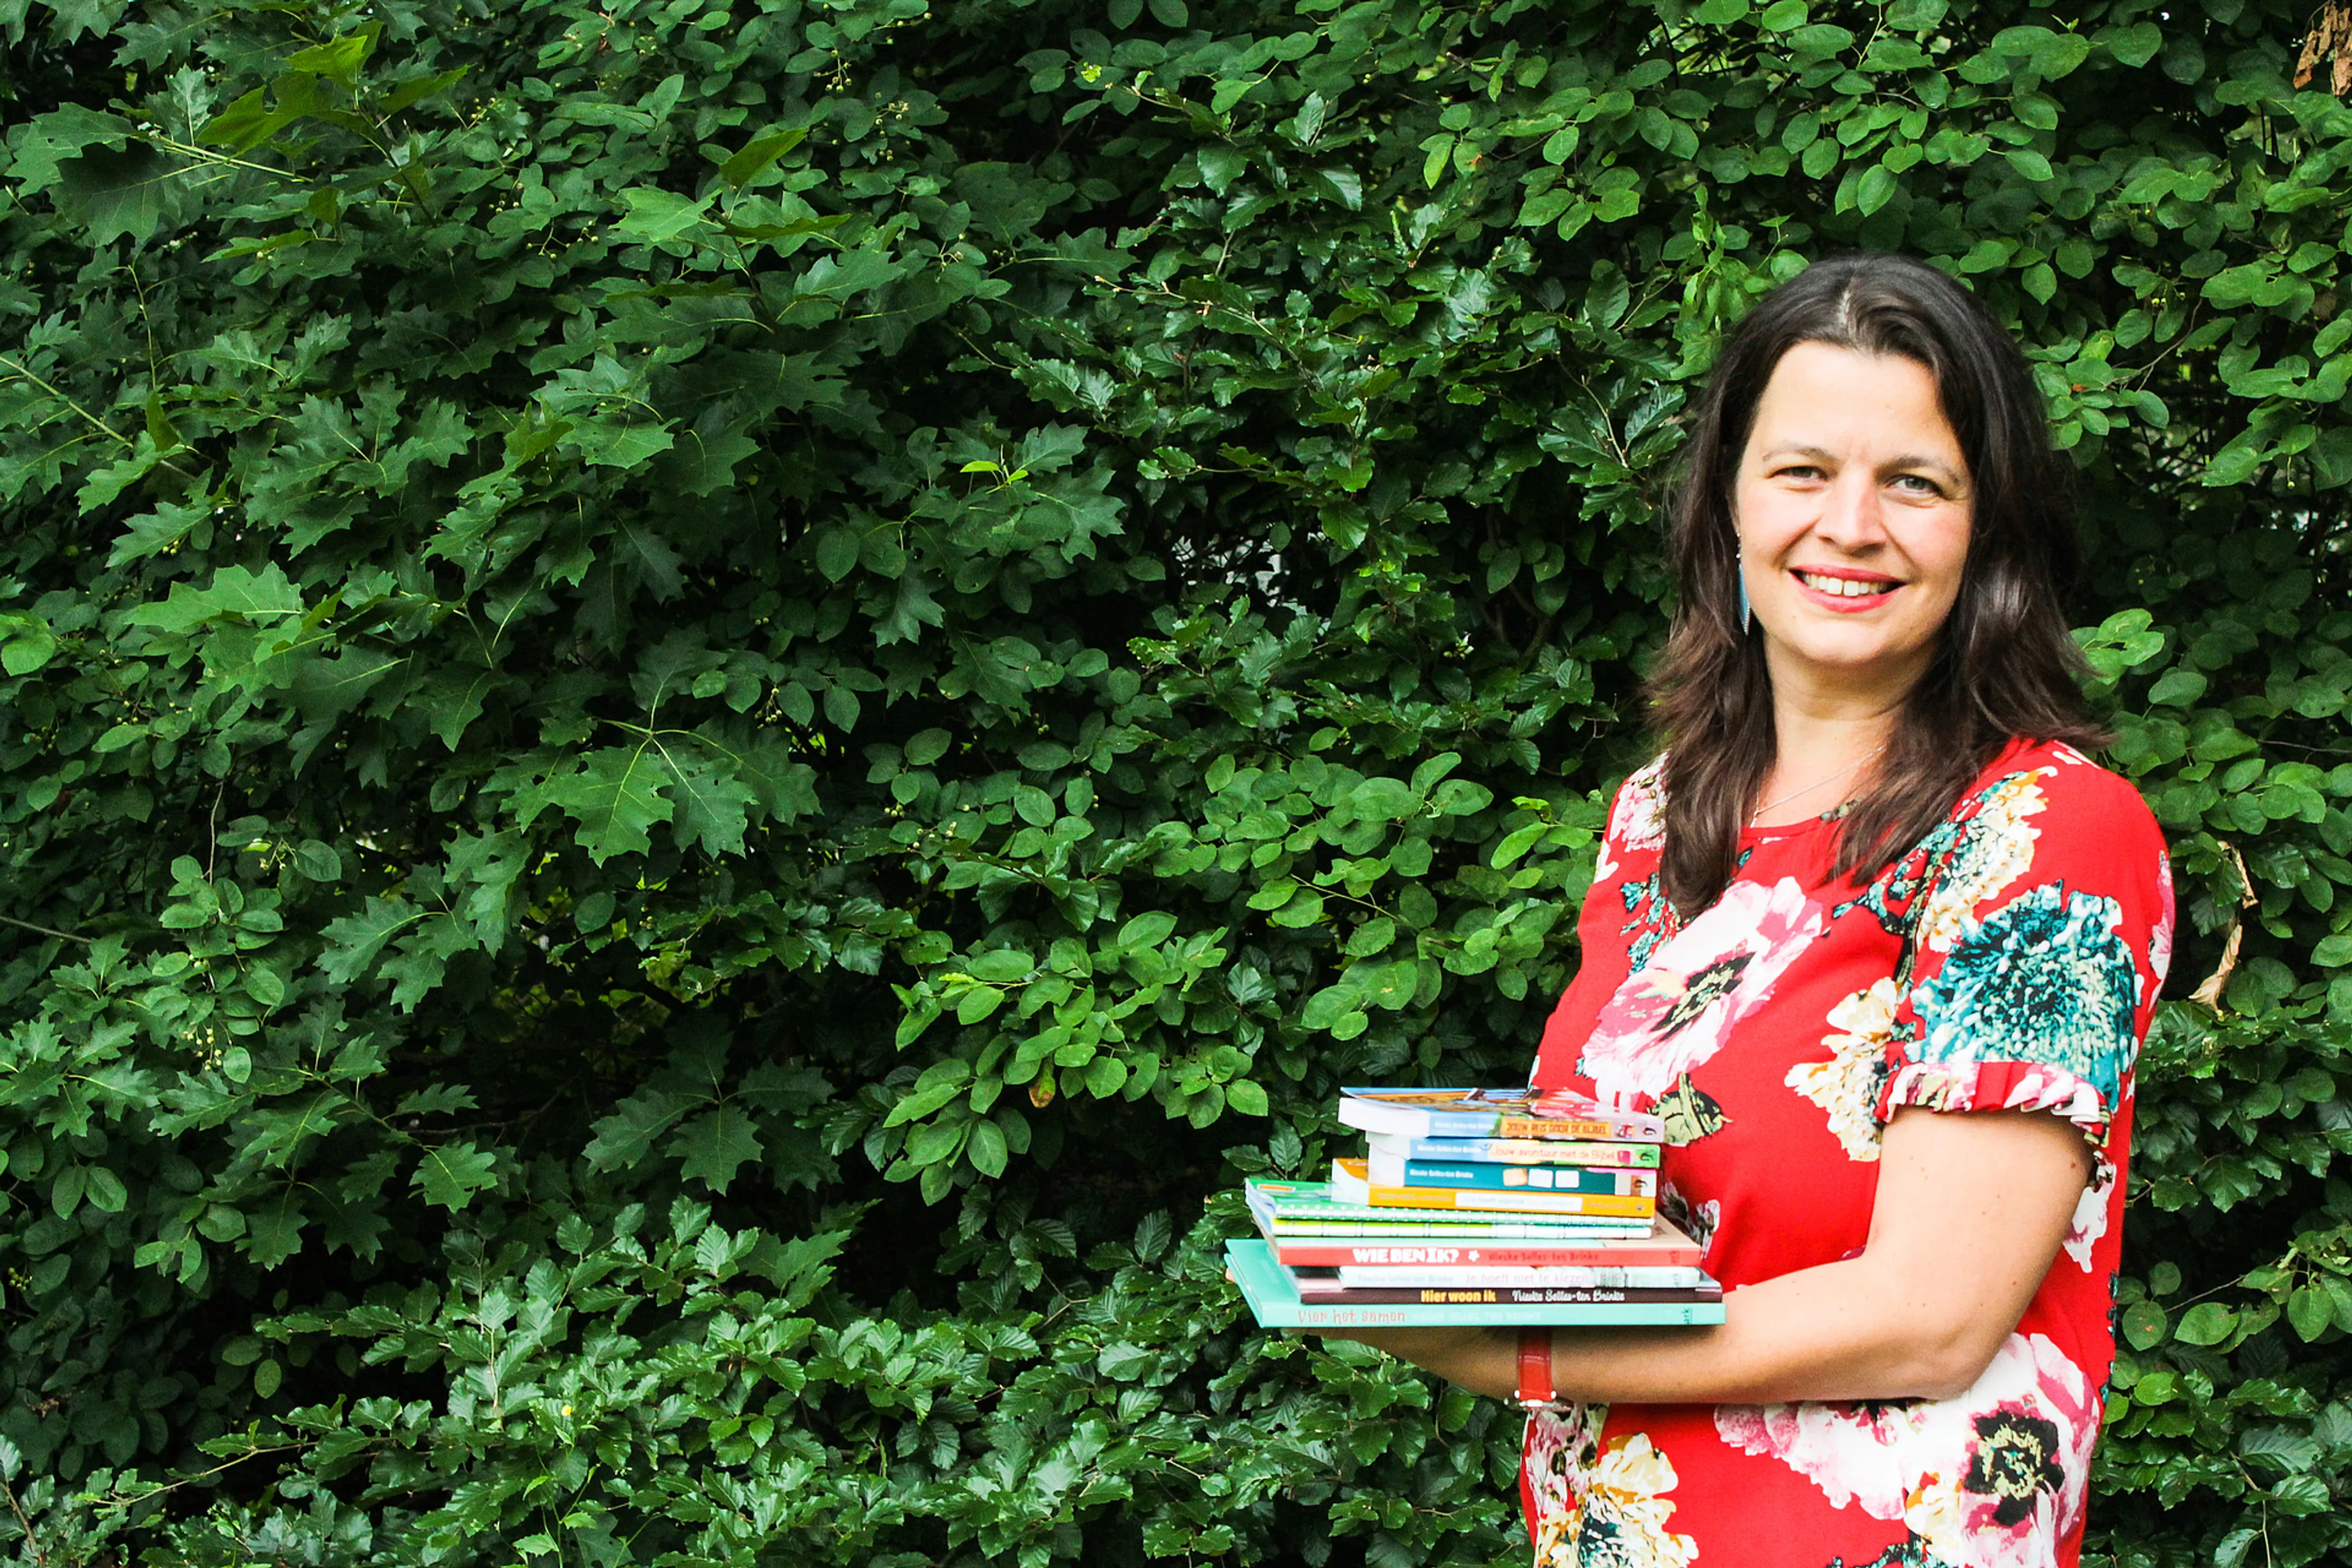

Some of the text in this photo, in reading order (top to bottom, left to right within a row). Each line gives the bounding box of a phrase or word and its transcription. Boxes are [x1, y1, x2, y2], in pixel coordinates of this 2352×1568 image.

[1507, 1123, 1528, 1133] JOUW
[1550, 1123, 1569, 1134] DOOR
[1582, 1125, 1607, 1134] BIJBEL
[1491, 1146, 1615, 1161] Jouw avontuur met de Bijbel
[1352, 1247, 1460, 1263] WIE BEN IK?
[1466, 1273, 1589, 1284] Je hoeft niet te kiezen
[1420, 1290, 1497, 1303] Hier woon ik
[1298, 1309, 1406, 1324] Vier het samen
